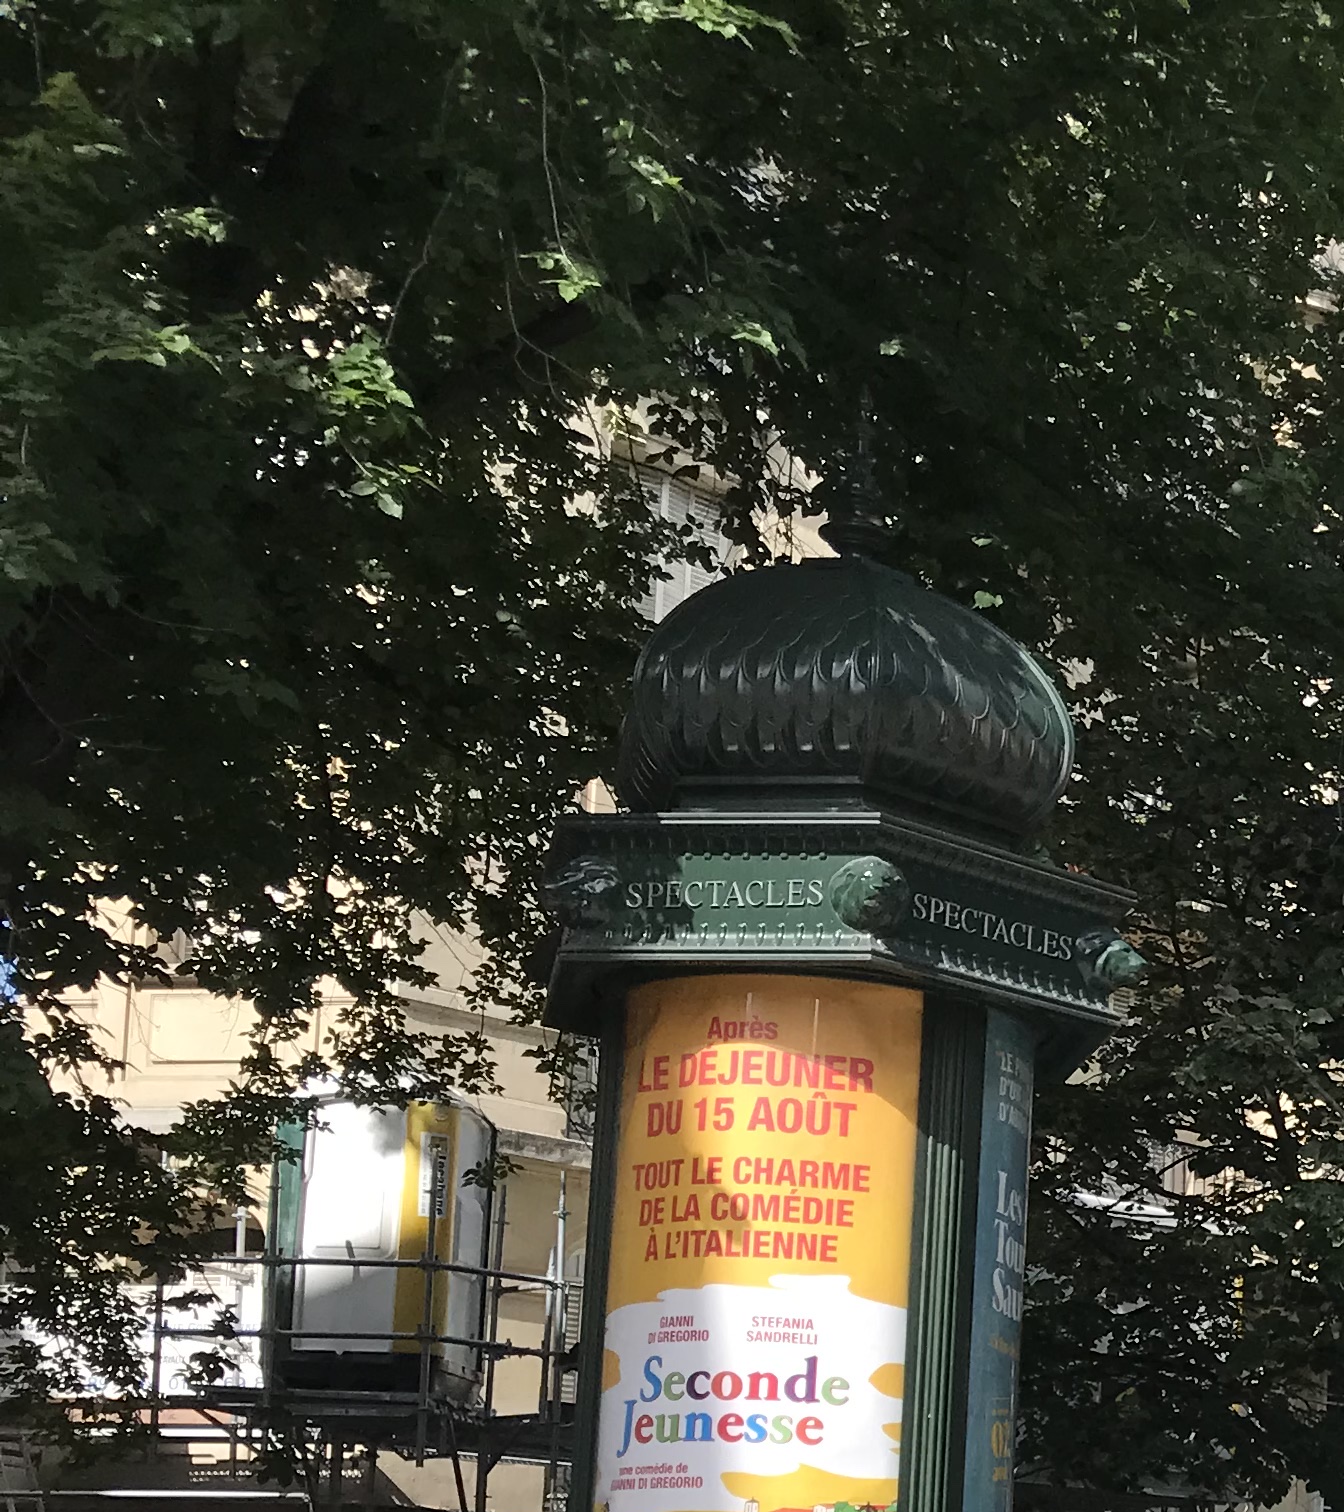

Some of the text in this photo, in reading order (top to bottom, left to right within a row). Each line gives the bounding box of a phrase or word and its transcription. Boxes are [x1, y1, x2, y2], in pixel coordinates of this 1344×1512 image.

[625, 879, 825, 910] SPECTACLES
[912, 893, 1073, 963] SPECTACLES
[707, 1015, 778, 1044] Après
[637, 1044, 875, 1094] LE DÉJEUNER
[646, 1090, 858, 1138] DU 15 AOÛT
[633, 1156, 871, 1193] TOUT LE CHARME
[639, 1187, 854, 1228] DE LA COMÉDIE
[996, 1170, 1023, 1226] Les
[644, 1226, 839, 1263] À L'ITALIENNE
[647, 1329, 709, 1344] DI GREGORIO
[659, 1315, 694, 1328] GIANNI
[746, 1330, 818, 1345] SANDRELLI
[751, 1316, 814, 1330] STEFANIA
[640, 1355, 849, 1406] Seconde
[617, 1400, 824, 1458] Jeunesse
[610, 1476, 703, 1491] GIANNI DI GREGORIO
[618, 1462, 688, 1476] une comédie de
